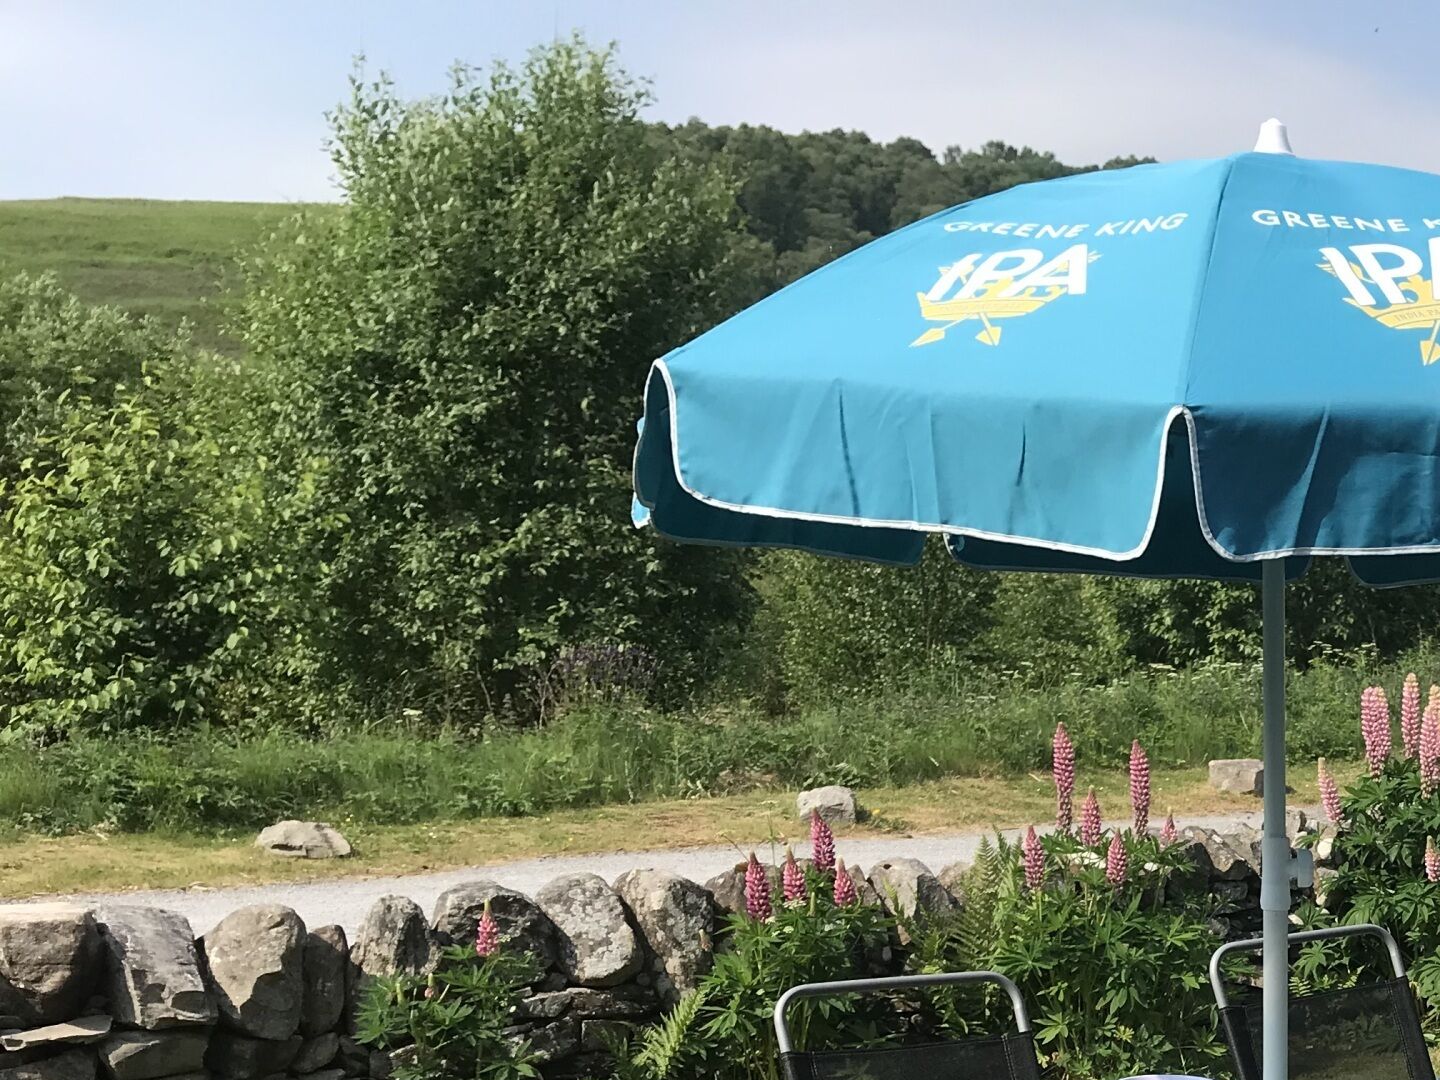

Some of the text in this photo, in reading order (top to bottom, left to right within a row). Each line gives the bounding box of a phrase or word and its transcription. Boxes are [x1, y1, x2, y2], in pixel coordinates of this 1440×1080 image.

[944, 212, 1189, 239] GREENE KING
[1252, 209, 1411, 232] GREENE
[924, 243, 1088, 301] IPA
[1394, 309, 1425, 322] INDIA
